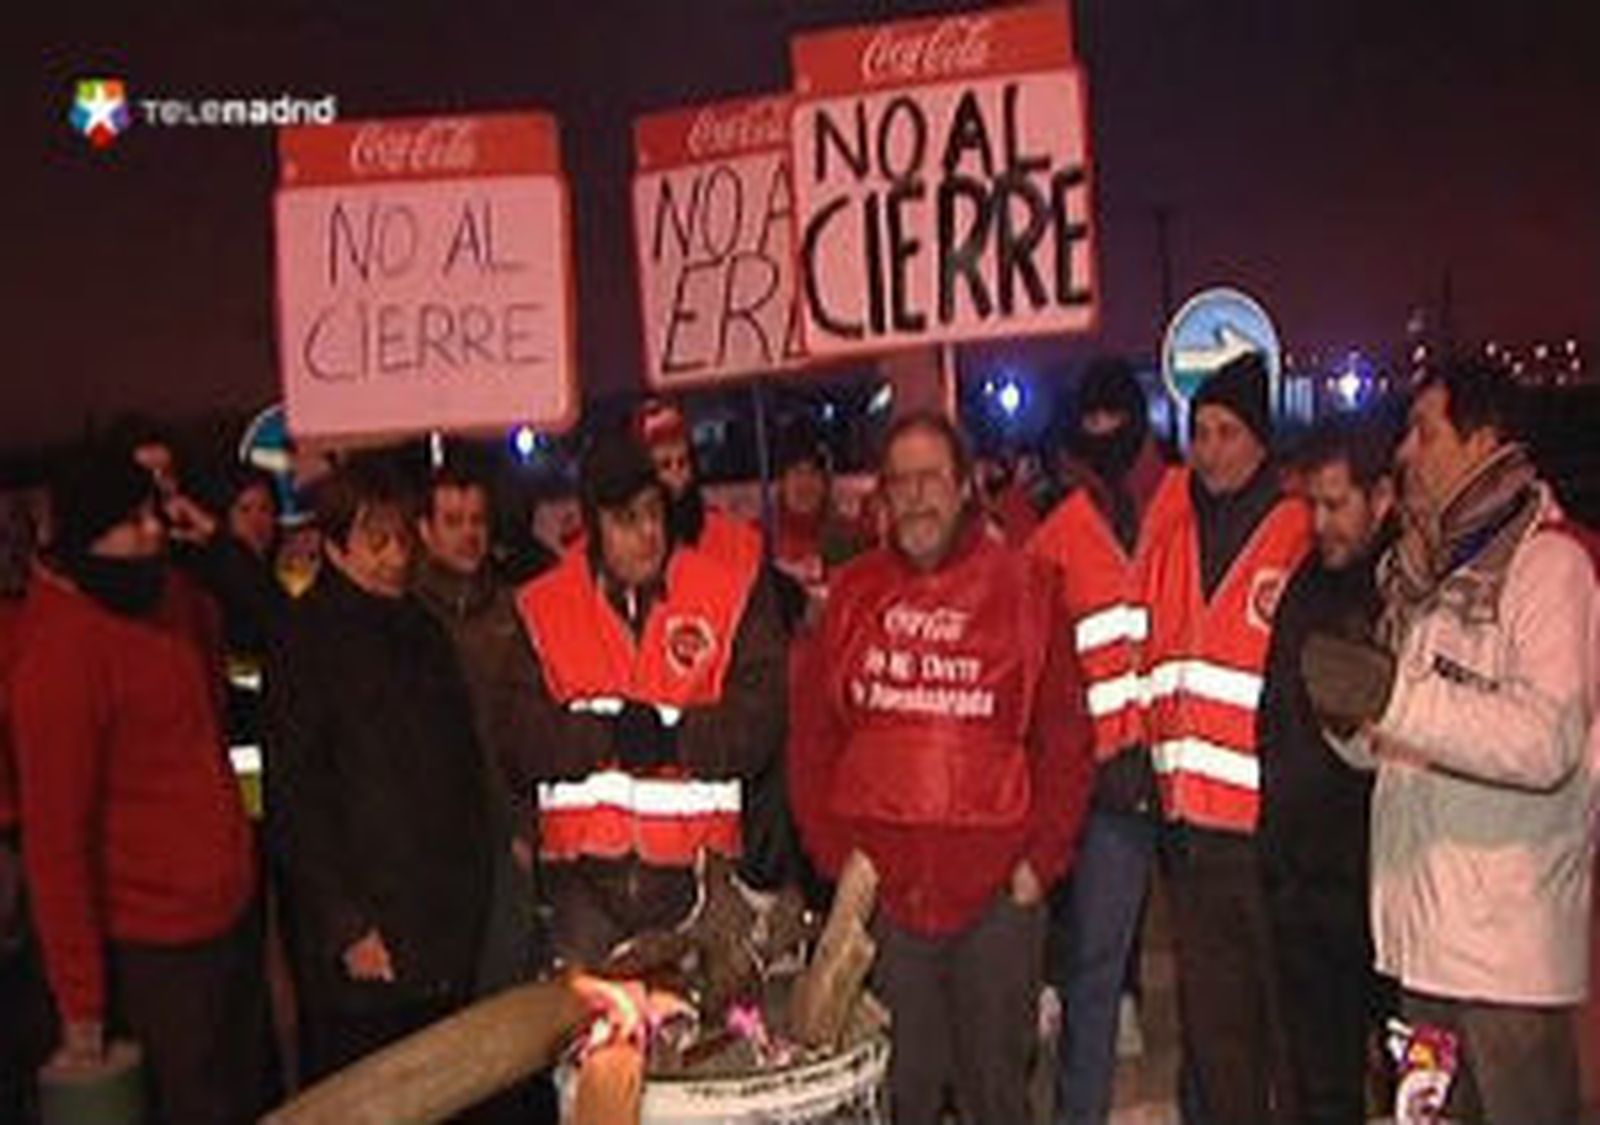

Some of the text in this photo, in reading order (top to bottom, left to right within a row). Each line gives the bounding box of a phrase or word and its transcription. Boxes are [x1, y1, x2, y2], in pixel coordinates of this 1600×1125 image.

[813, 84, 1052, 184] NO AL
[328, 199, 529, 287] NO AL
[653, 162, 794, 262] NO A
[803, 168, 1093, 339] CIERRE
[304, 302, 547, 382] CIERRE
